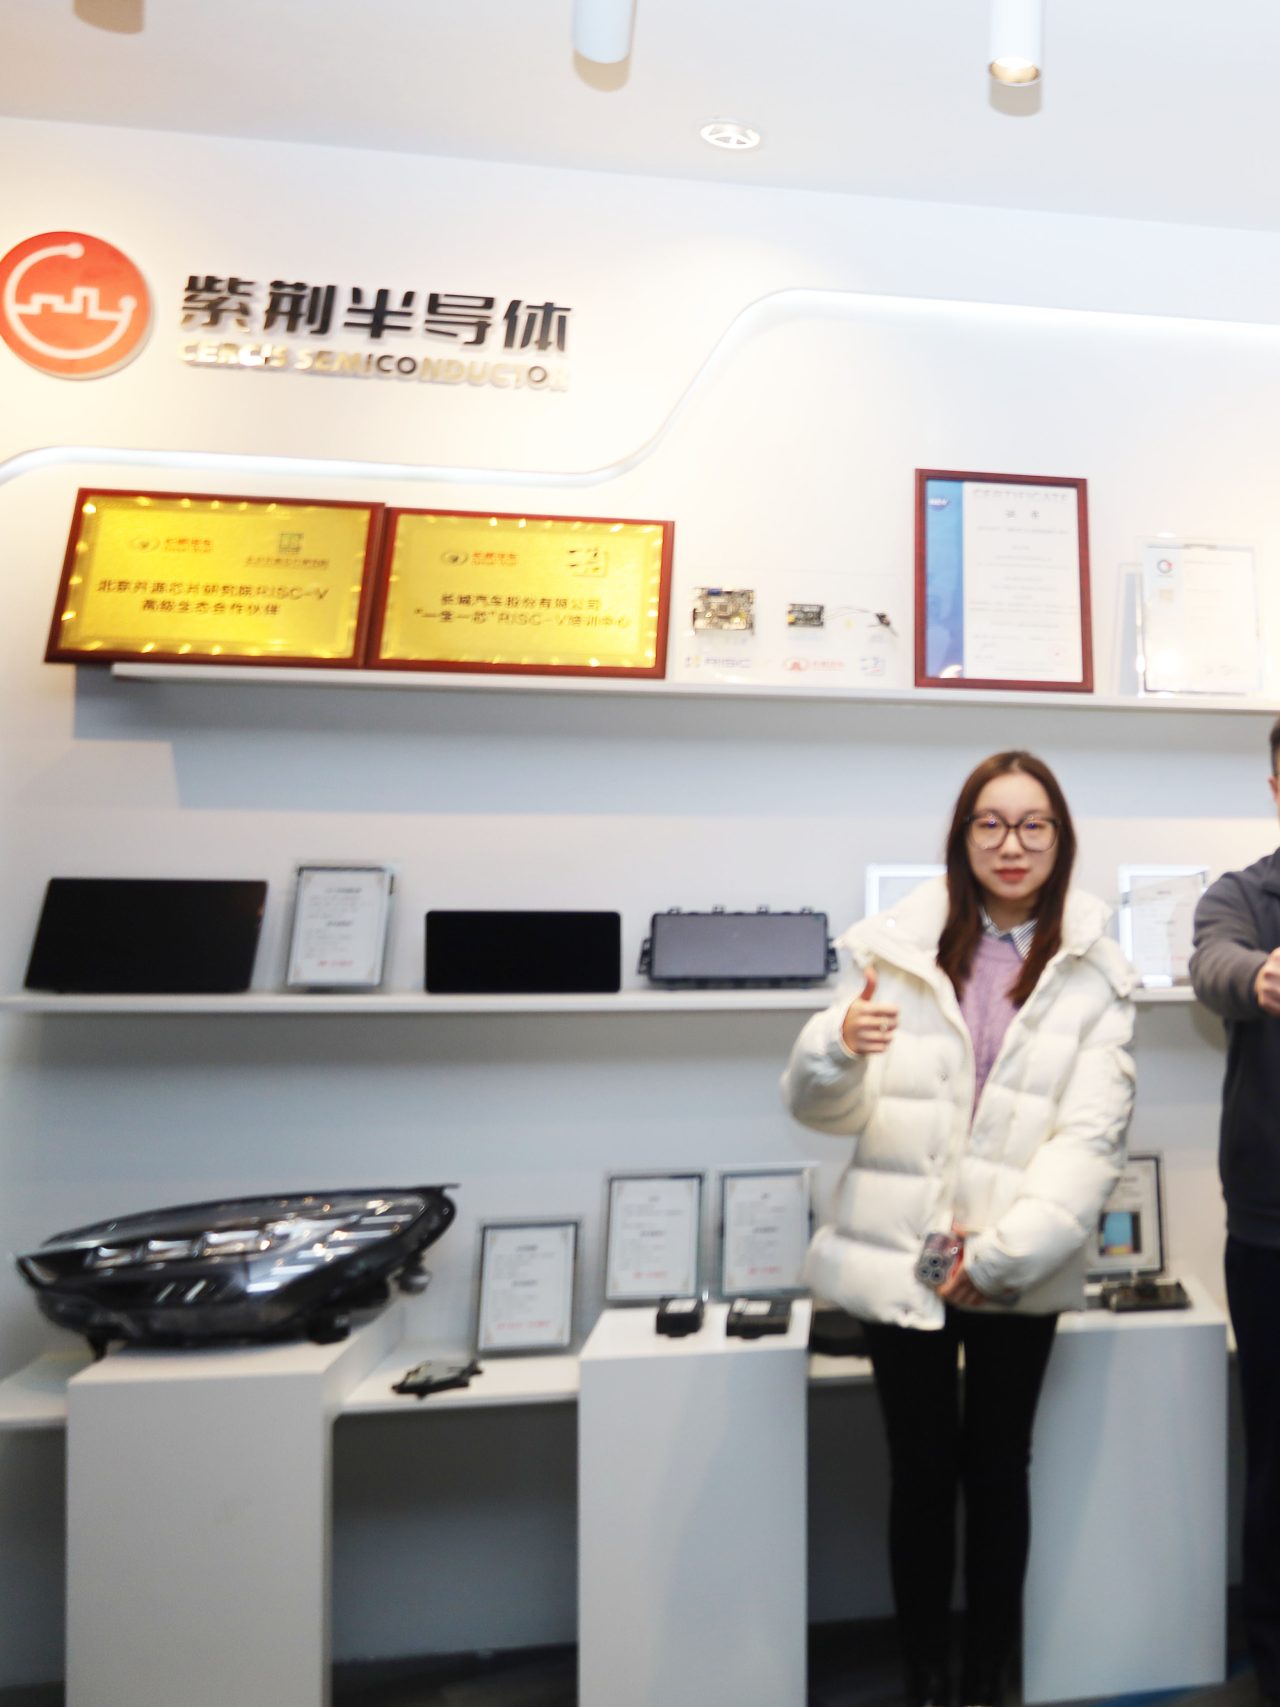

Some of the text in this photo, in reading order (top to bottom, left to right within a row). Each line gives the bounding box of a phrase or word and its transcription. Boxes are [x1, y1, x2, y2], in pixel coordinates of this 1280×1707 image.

[180, 273, 572, 352] 紫荆半导体
